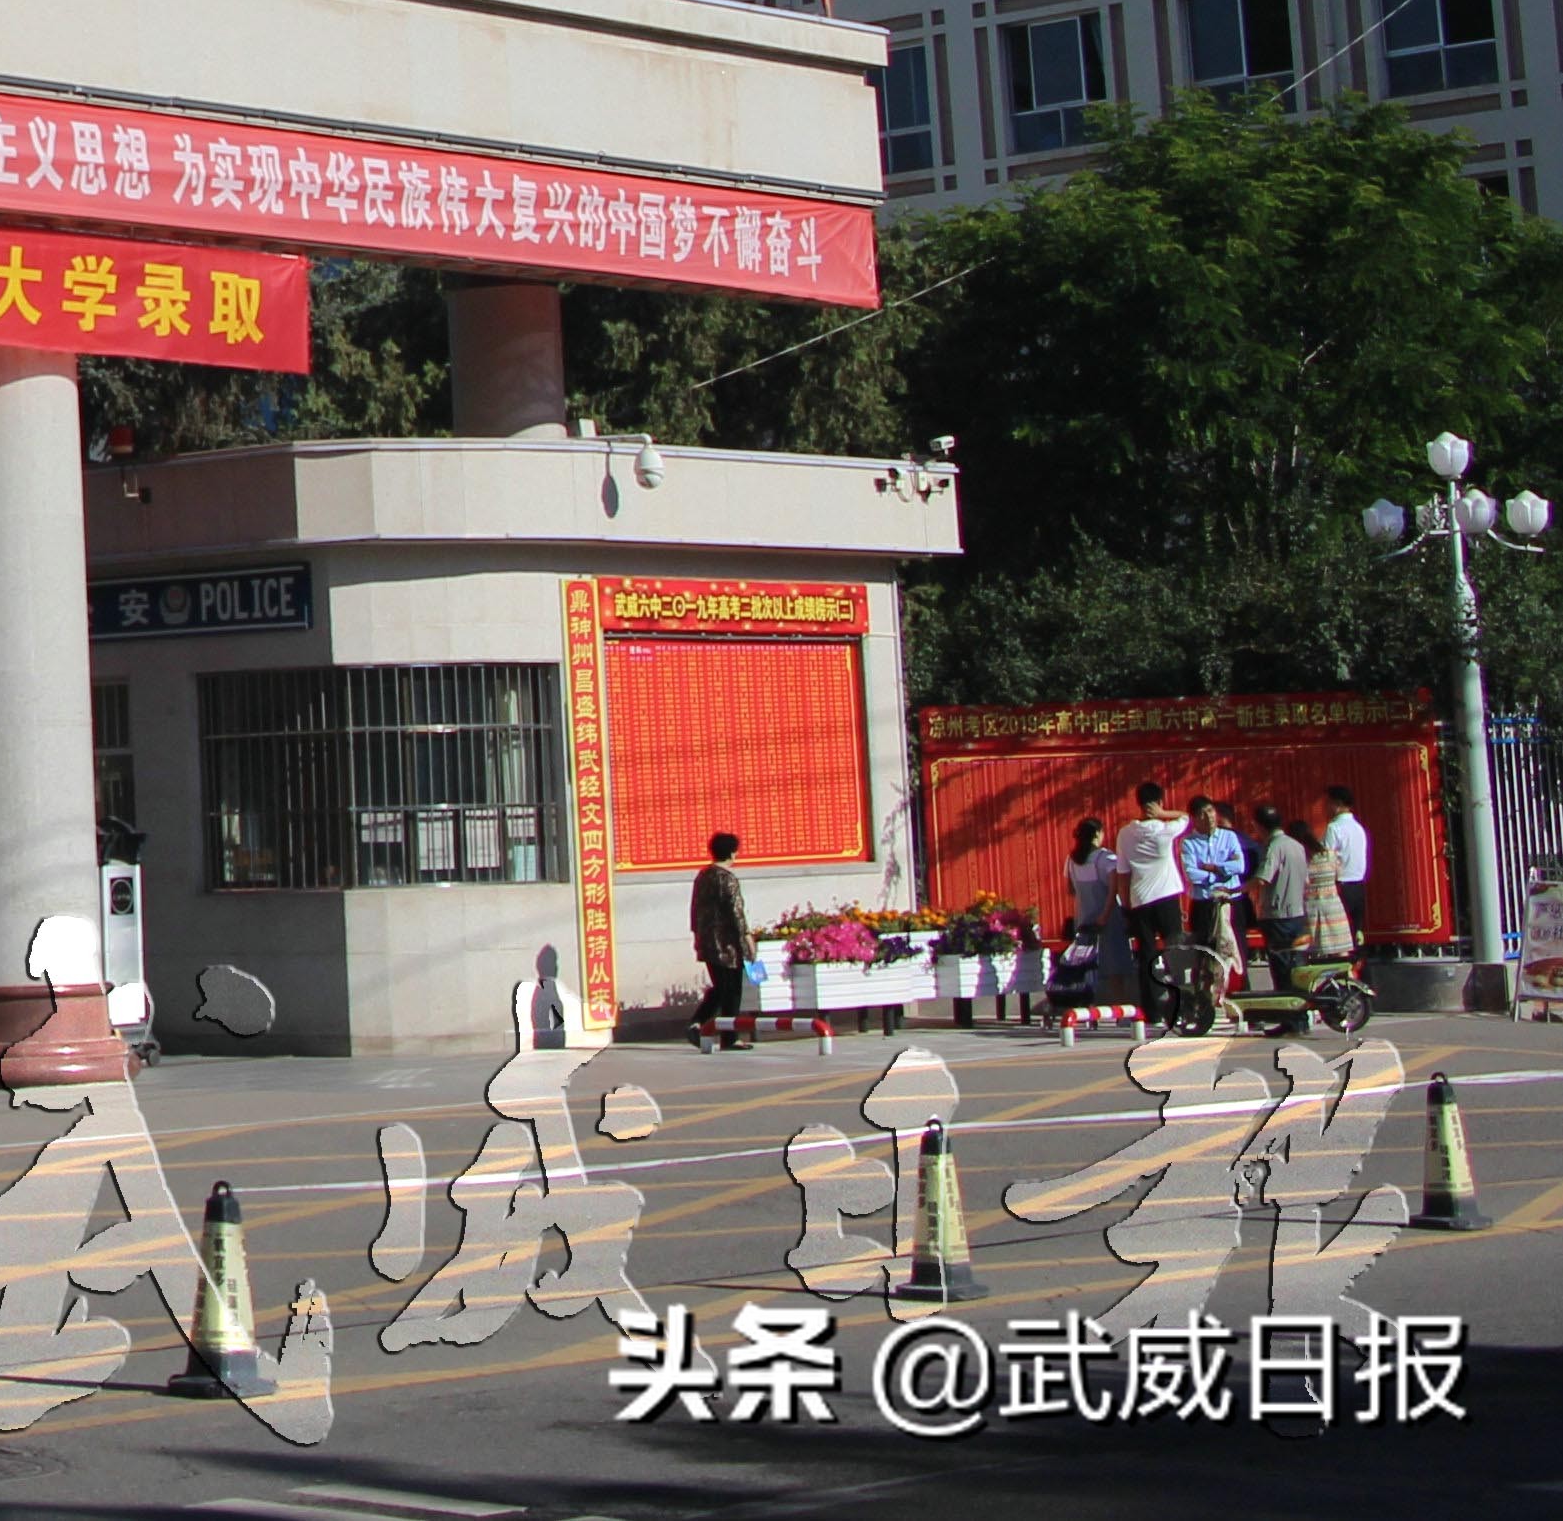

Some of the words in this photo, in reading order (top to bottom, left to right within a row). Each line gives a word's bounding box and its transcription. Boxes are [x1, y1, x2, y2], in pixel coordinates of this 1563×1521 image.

[173, 133, 823, 284] 为实现中华民族伟大复兴的中国梦不懈奋斗
[199, 576, 295, 622] POLICE
